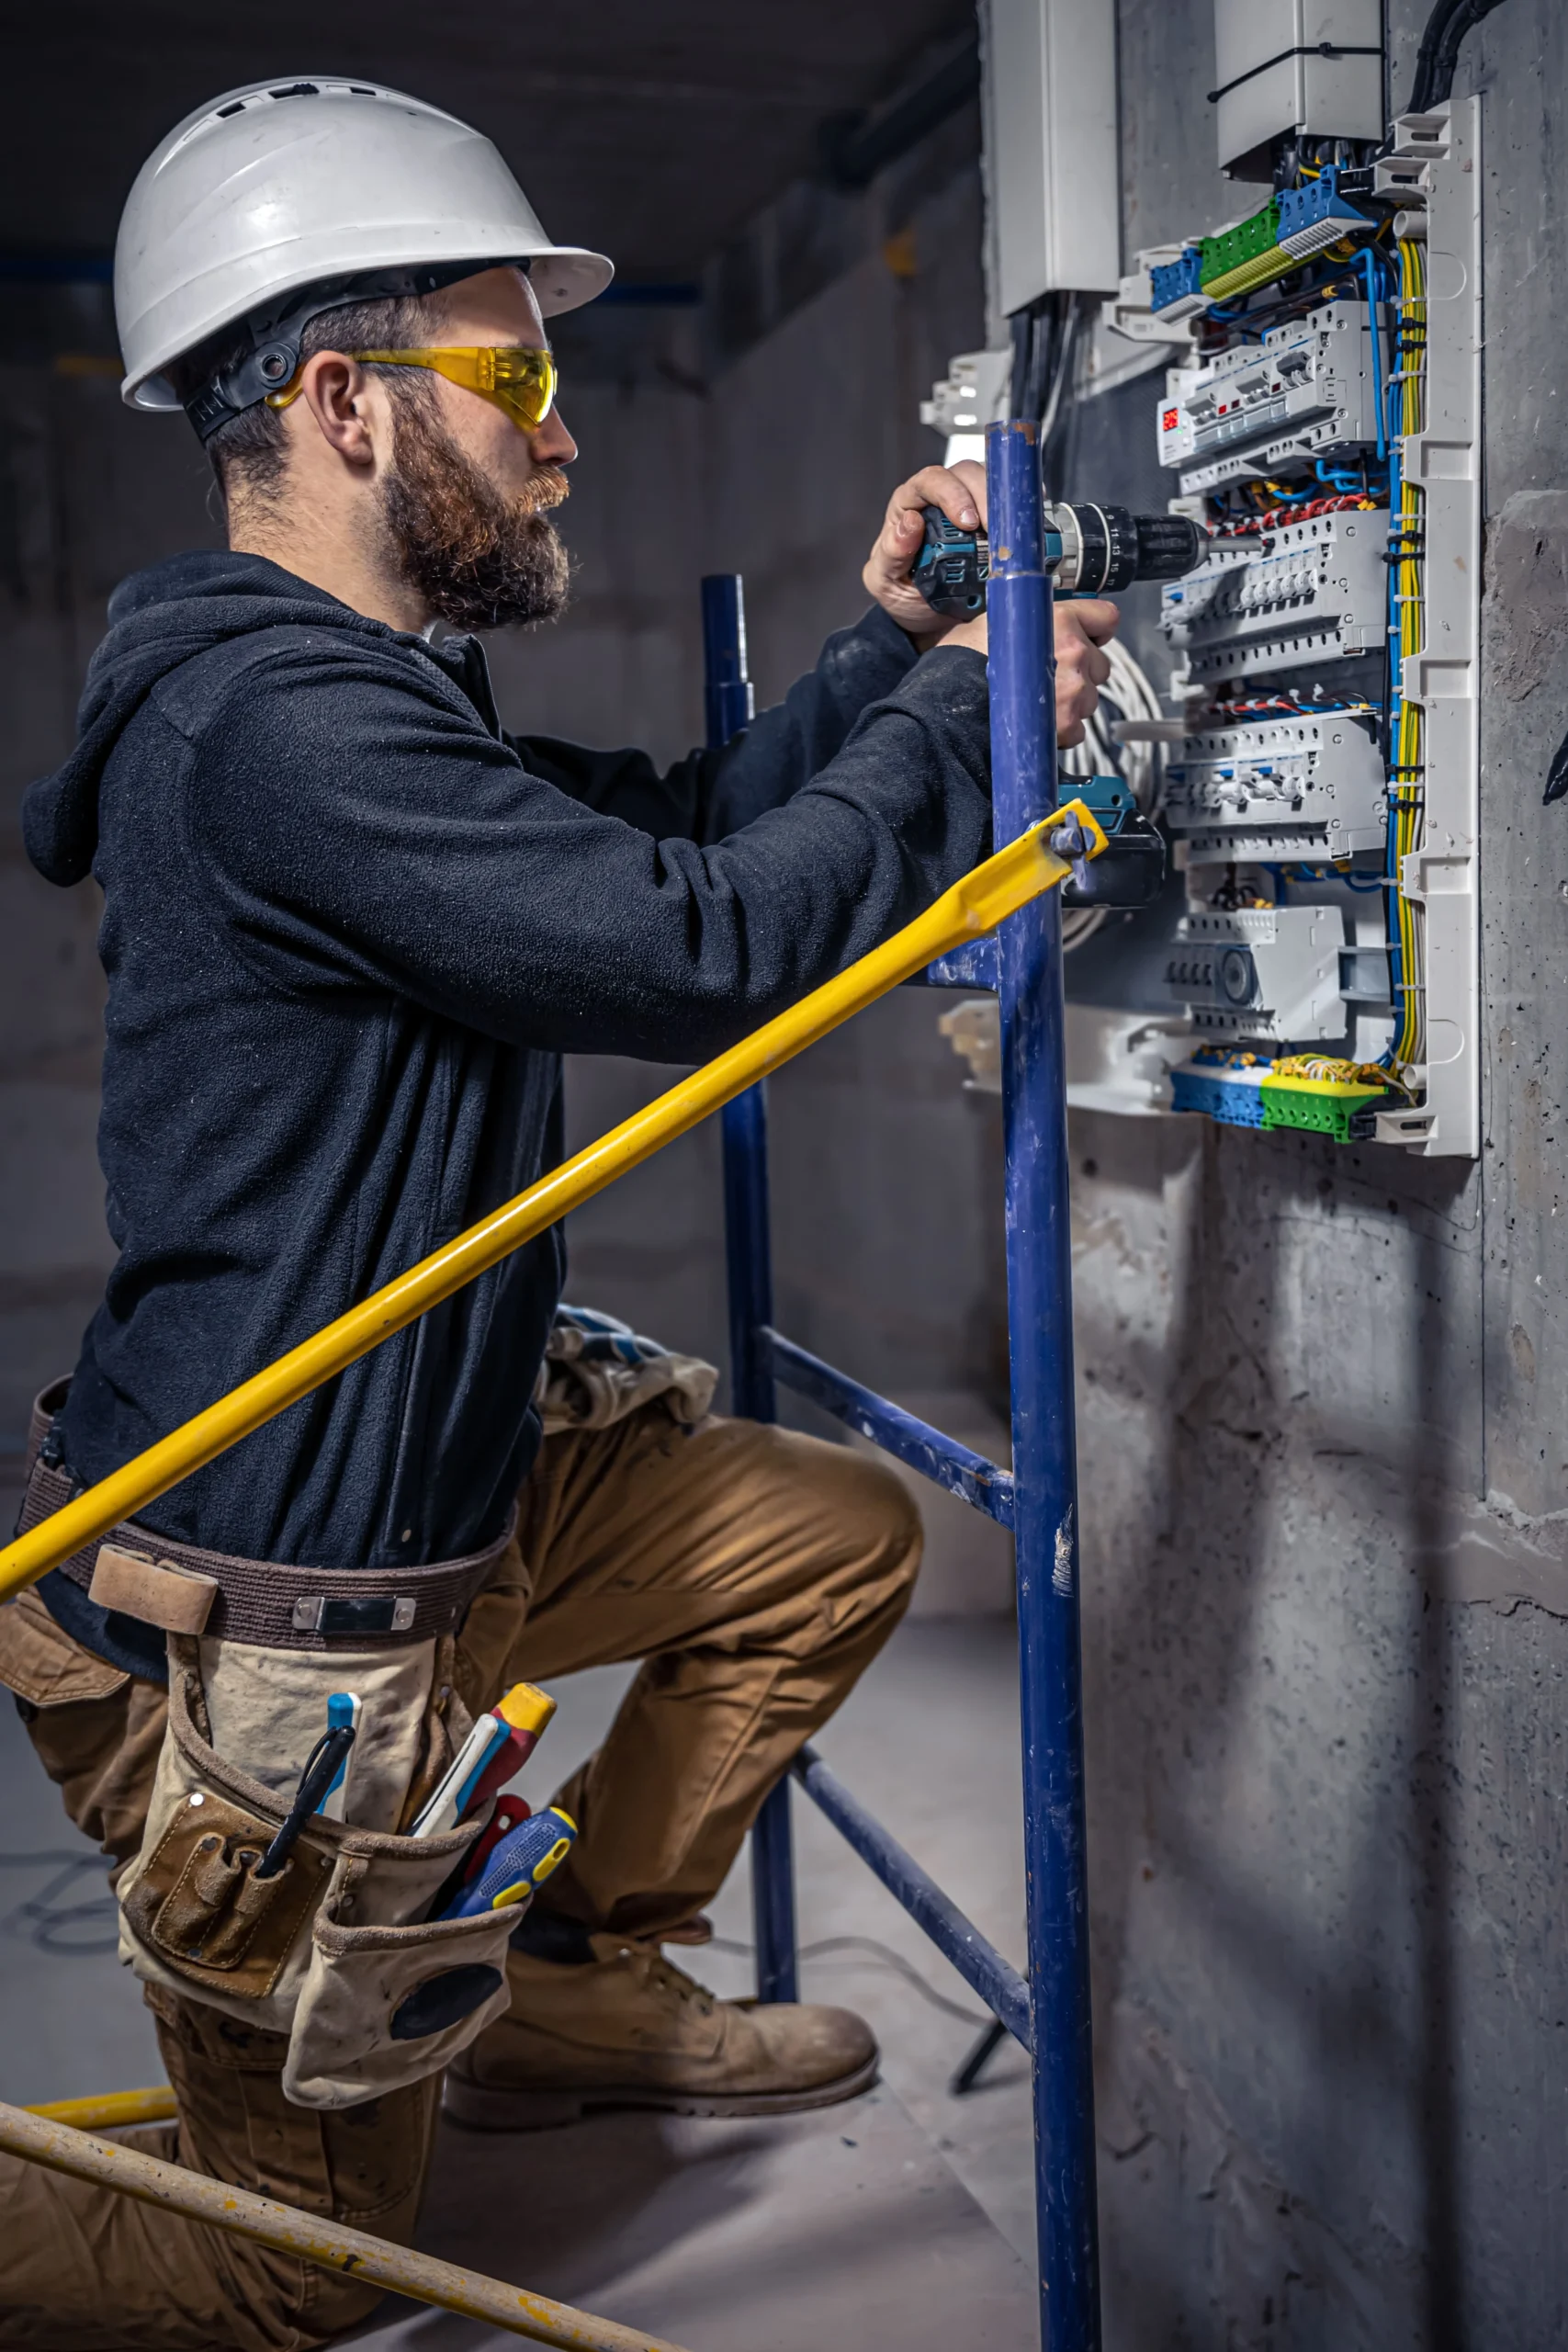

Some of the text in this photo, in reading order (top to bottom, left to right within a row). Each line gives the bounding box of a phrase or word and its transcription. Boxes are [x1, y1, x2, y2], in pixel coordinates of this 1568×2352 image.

[1111, 527, 1120, 537] 11
[1111, 545, 1121, 556] 13
[1111, 562, 1120, 572] 15
